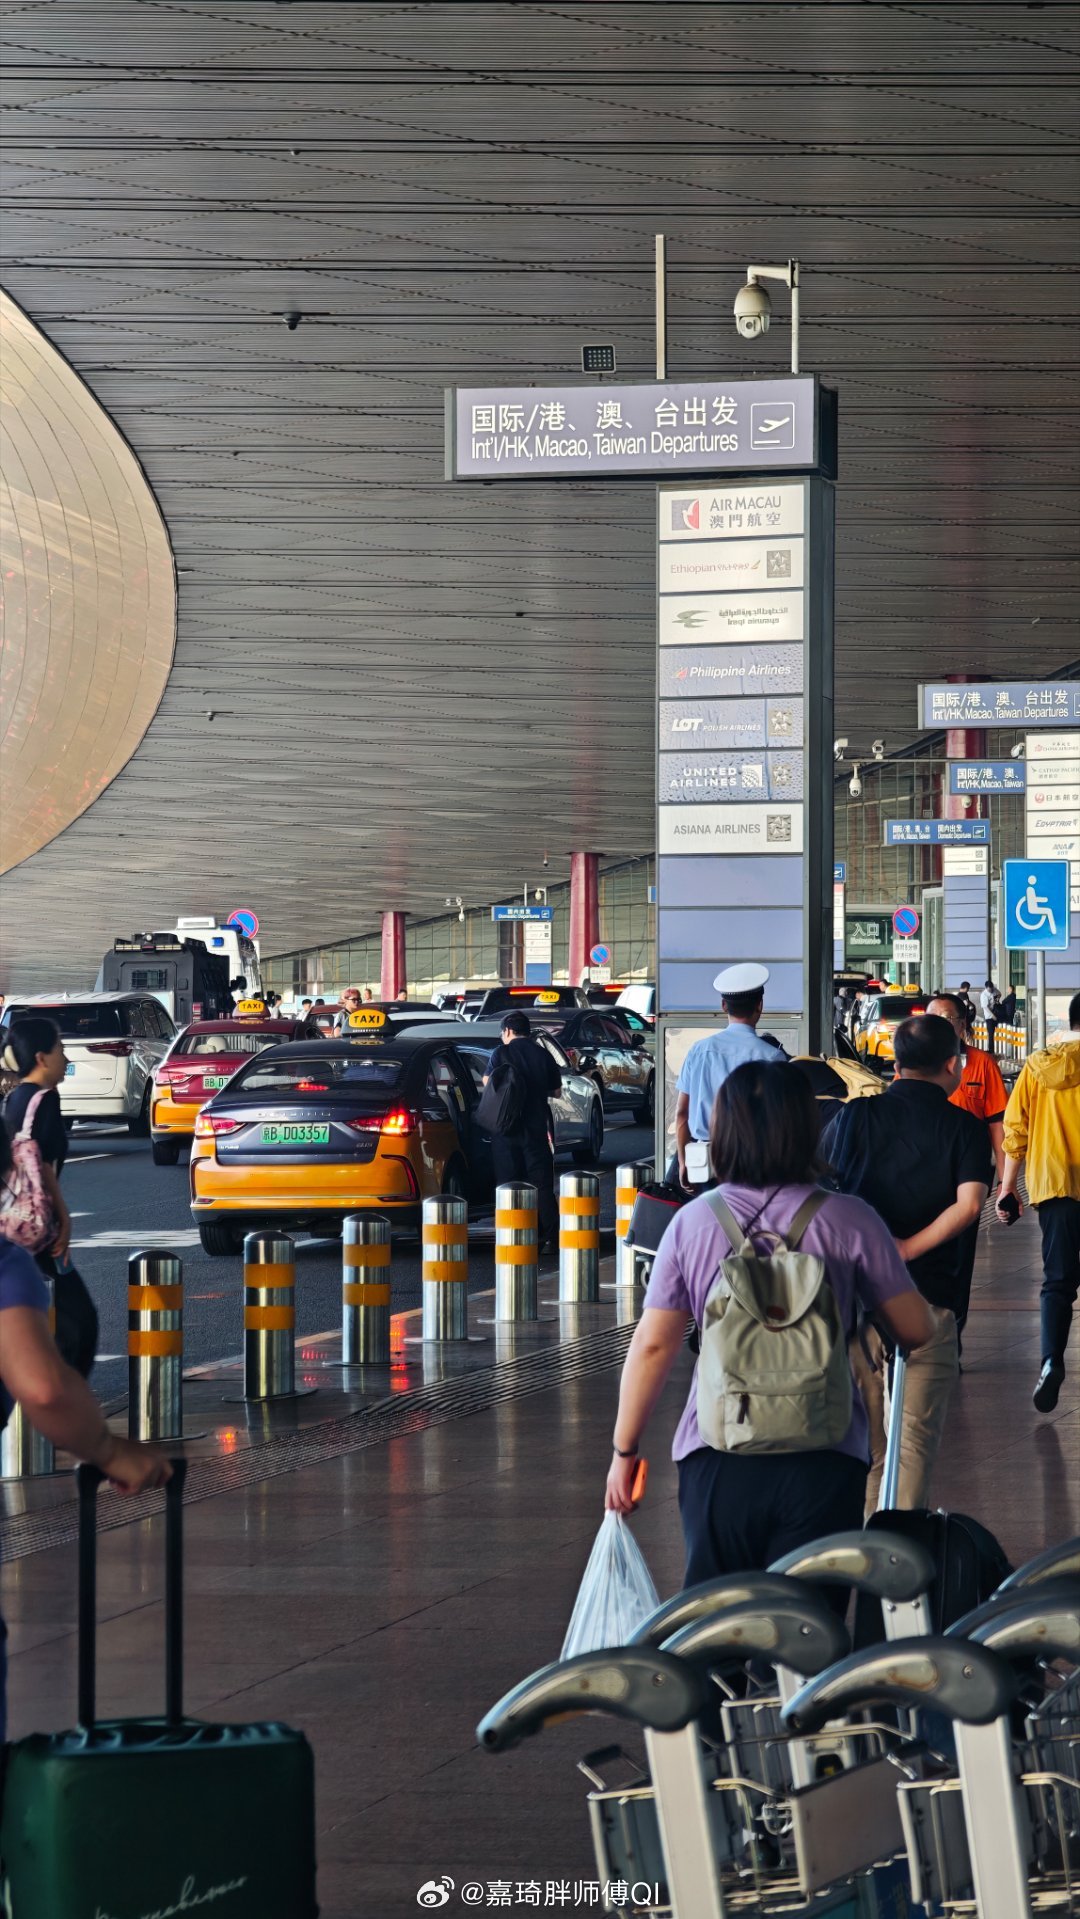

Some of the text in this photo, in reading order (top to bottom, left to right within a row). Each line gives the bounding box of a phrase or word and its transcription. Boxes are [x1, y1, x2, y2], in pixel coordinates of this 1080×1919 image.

[471, 396, 739, 434] 国际/港、澳、台出发
[535, 434, 592, 461] Macao,
[593, 433, 649, 456] Taiwan
[650, 431, 739, 458] Departures
[710, 495, 782, 511] AIR MACAU
[709, 512, 781, 529] 澳門航空
[671, 564, 716, 574] Ethiopian
[689, 664, 791, 679] Philippine Airlines
[995, 707, 1022, 719] Taiwan
[1024, 706, 1069, 720] Departures
[671, 718, 703, 731] LOT
[683, 767, 737, 777] UNITED
[670, 778, 737, 788] AIRLINES
[673, 823, 761, 835] ASIANA AIRLINES
[853, 923, 879, 936] 入口
[354, 1015, 380, 1023] TAXI
